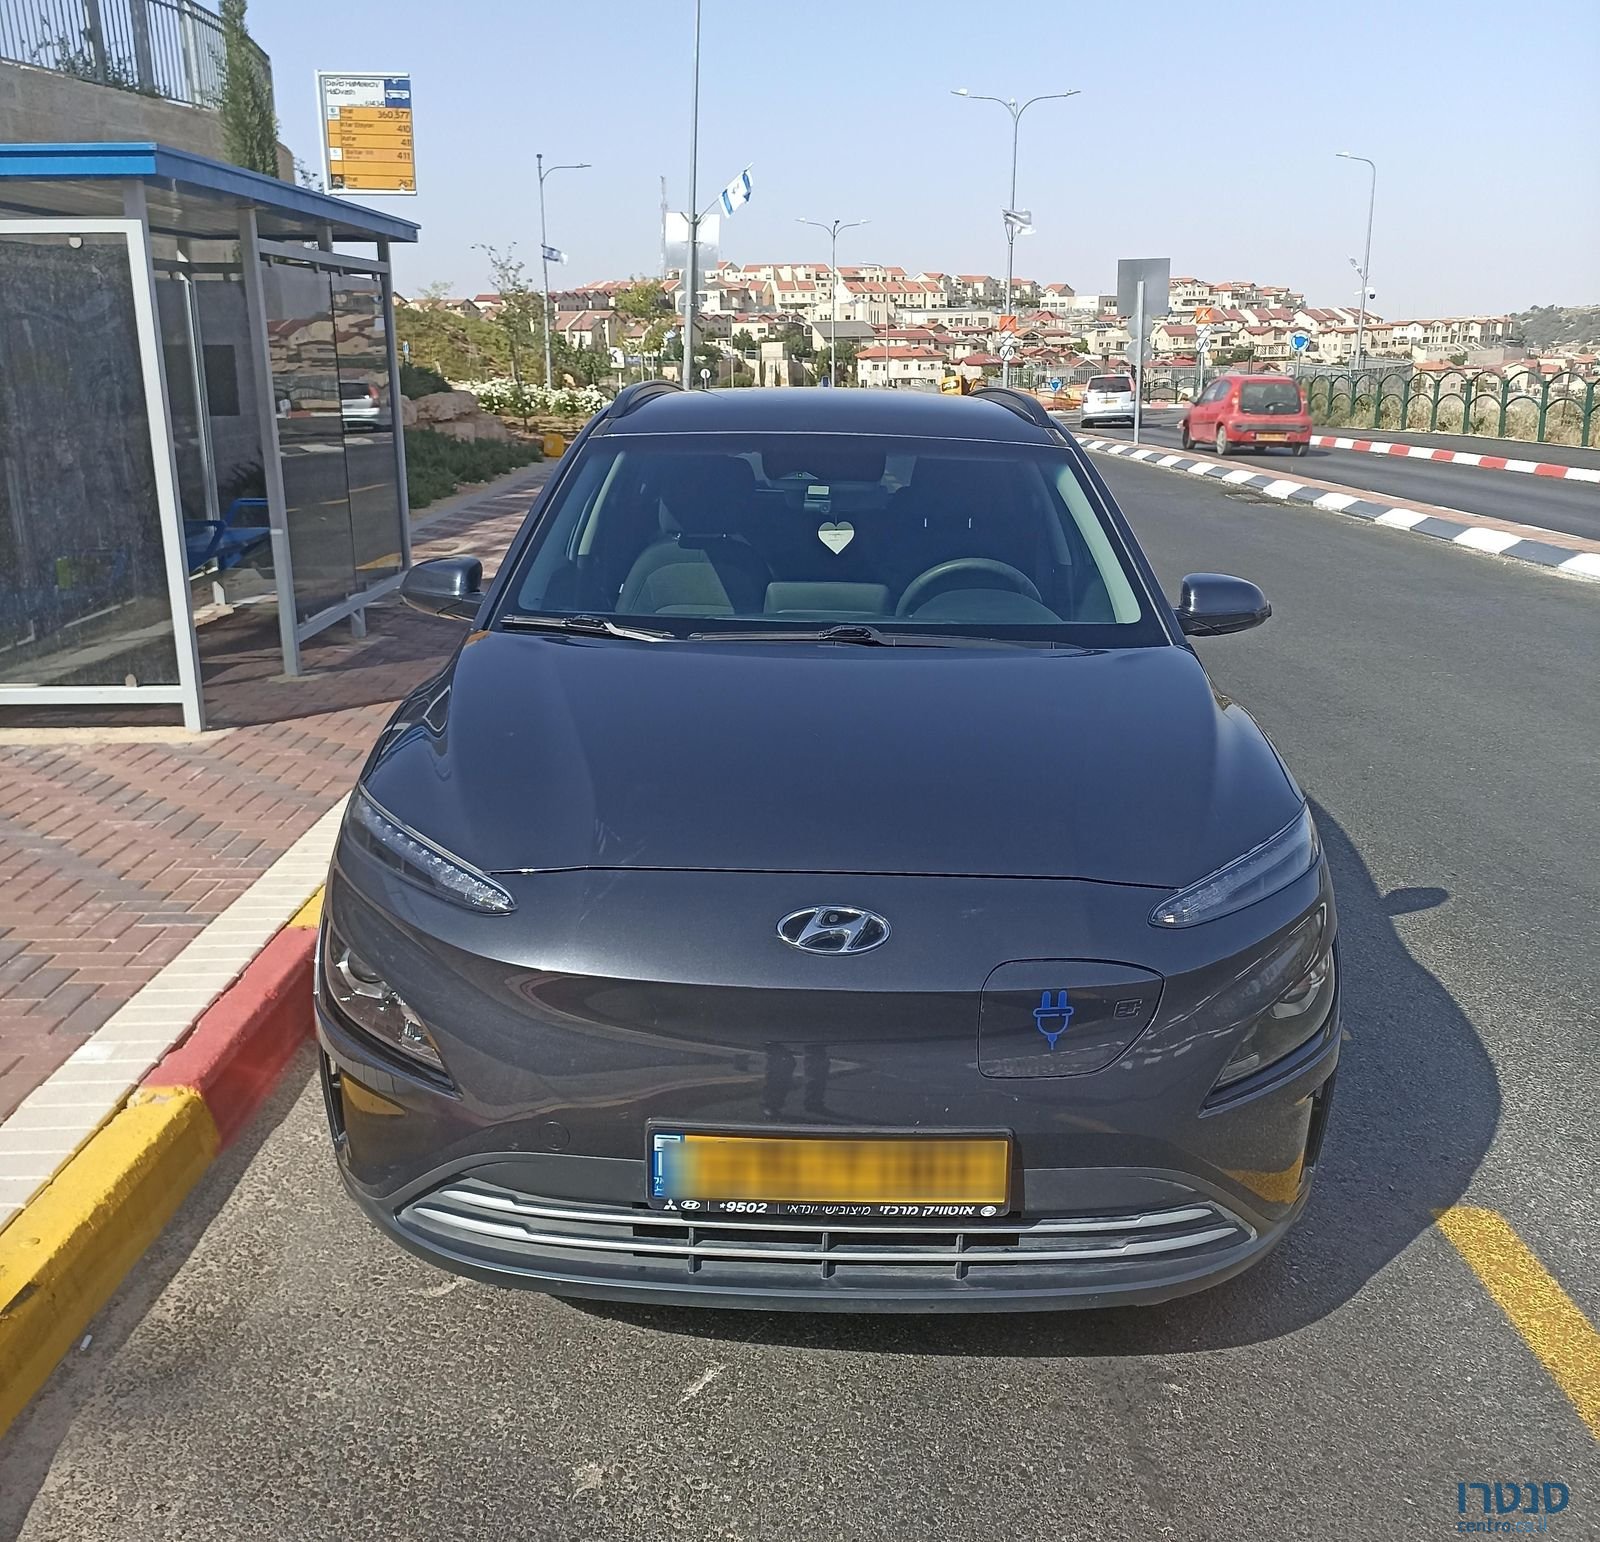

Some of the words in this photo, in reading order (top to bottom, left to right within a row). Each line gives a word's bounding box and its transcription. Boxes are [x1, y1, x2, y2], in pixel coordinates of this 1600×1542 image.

[397, 125, 411, 133] 410
[397, 152, 410, 160] 411
[786, 1203, 818, 1215] יונדאי
[822, 1204, 871, 1216] מיצובישי
[879, 1205, 920, 1215] מרכזי
[921, 1205, 976, 1217] אוטוויק
